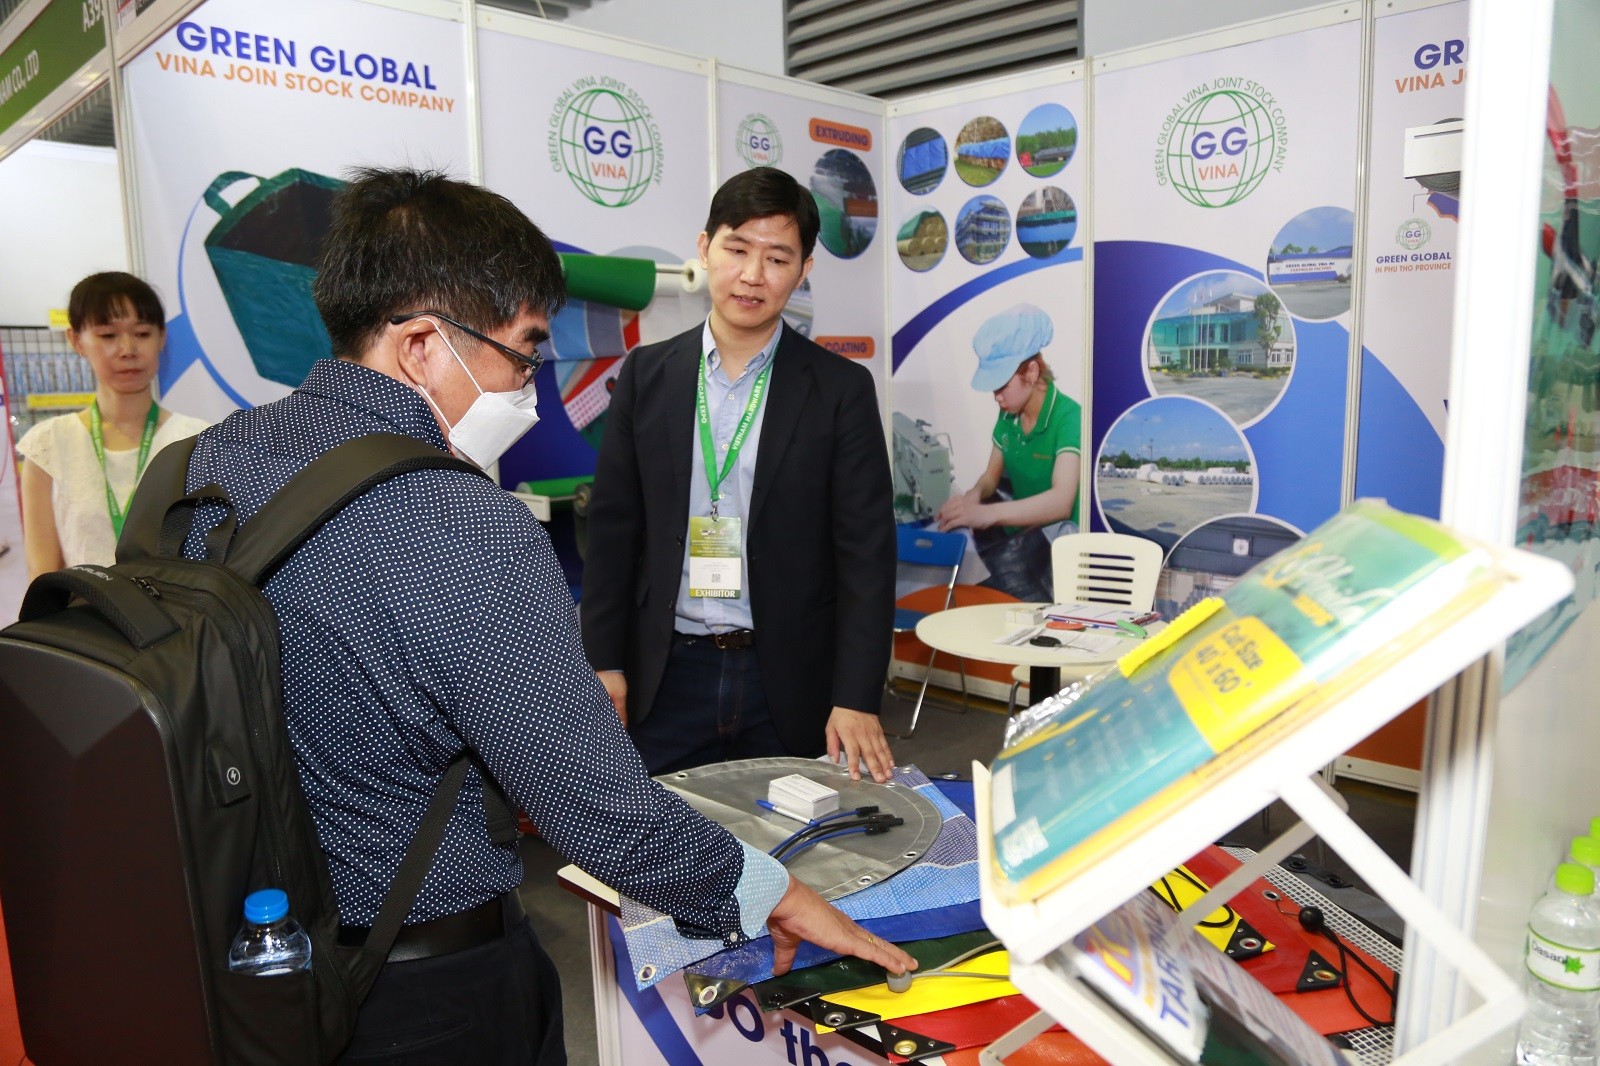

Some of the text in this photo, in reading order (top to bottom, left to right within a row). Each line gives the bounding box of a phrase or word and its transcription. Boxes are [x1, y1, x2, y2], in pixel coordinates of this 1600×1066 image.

[25, 49, 39, 81] LTD
[177, 22, 436, 90] GREEN GLOBAL
[1414, 37, 1469, 69] GR
[156, 52, 454, 113] VINA JOIN STOCK COMPANY
[1395, 69, 1466, 93] VINA J
[548, 75, 664, 185] GREEN GLOBAL VINA JOINT STOCK COMPANY
[815, 125, 868, 146] EXTRUDING
[1155, 77, 1288, 187] GREEN GLOBAL VINA JOINT STOCK COMPANY
[591, 161, 627, 180] VINA
[1198, 163, 1239, 181] VINA
[1376, 252, 1451, 264] GREEN GLOBAL
[1384, 265, 1398, 273] PHU
[1400, 264, 1413, 272] THO
[1415, 262, 1452, 271] PROVINCE
[825, 342, 867, 353] COATING
[732, 421, 749, 450] VIETNAM
[745, 385, 762, 422] HARDWARE
[695, 589, 736, 598] EXHIBITOR
[1236, 640, 1263, 670] Size
[780, 1018, 853, 1066] th
